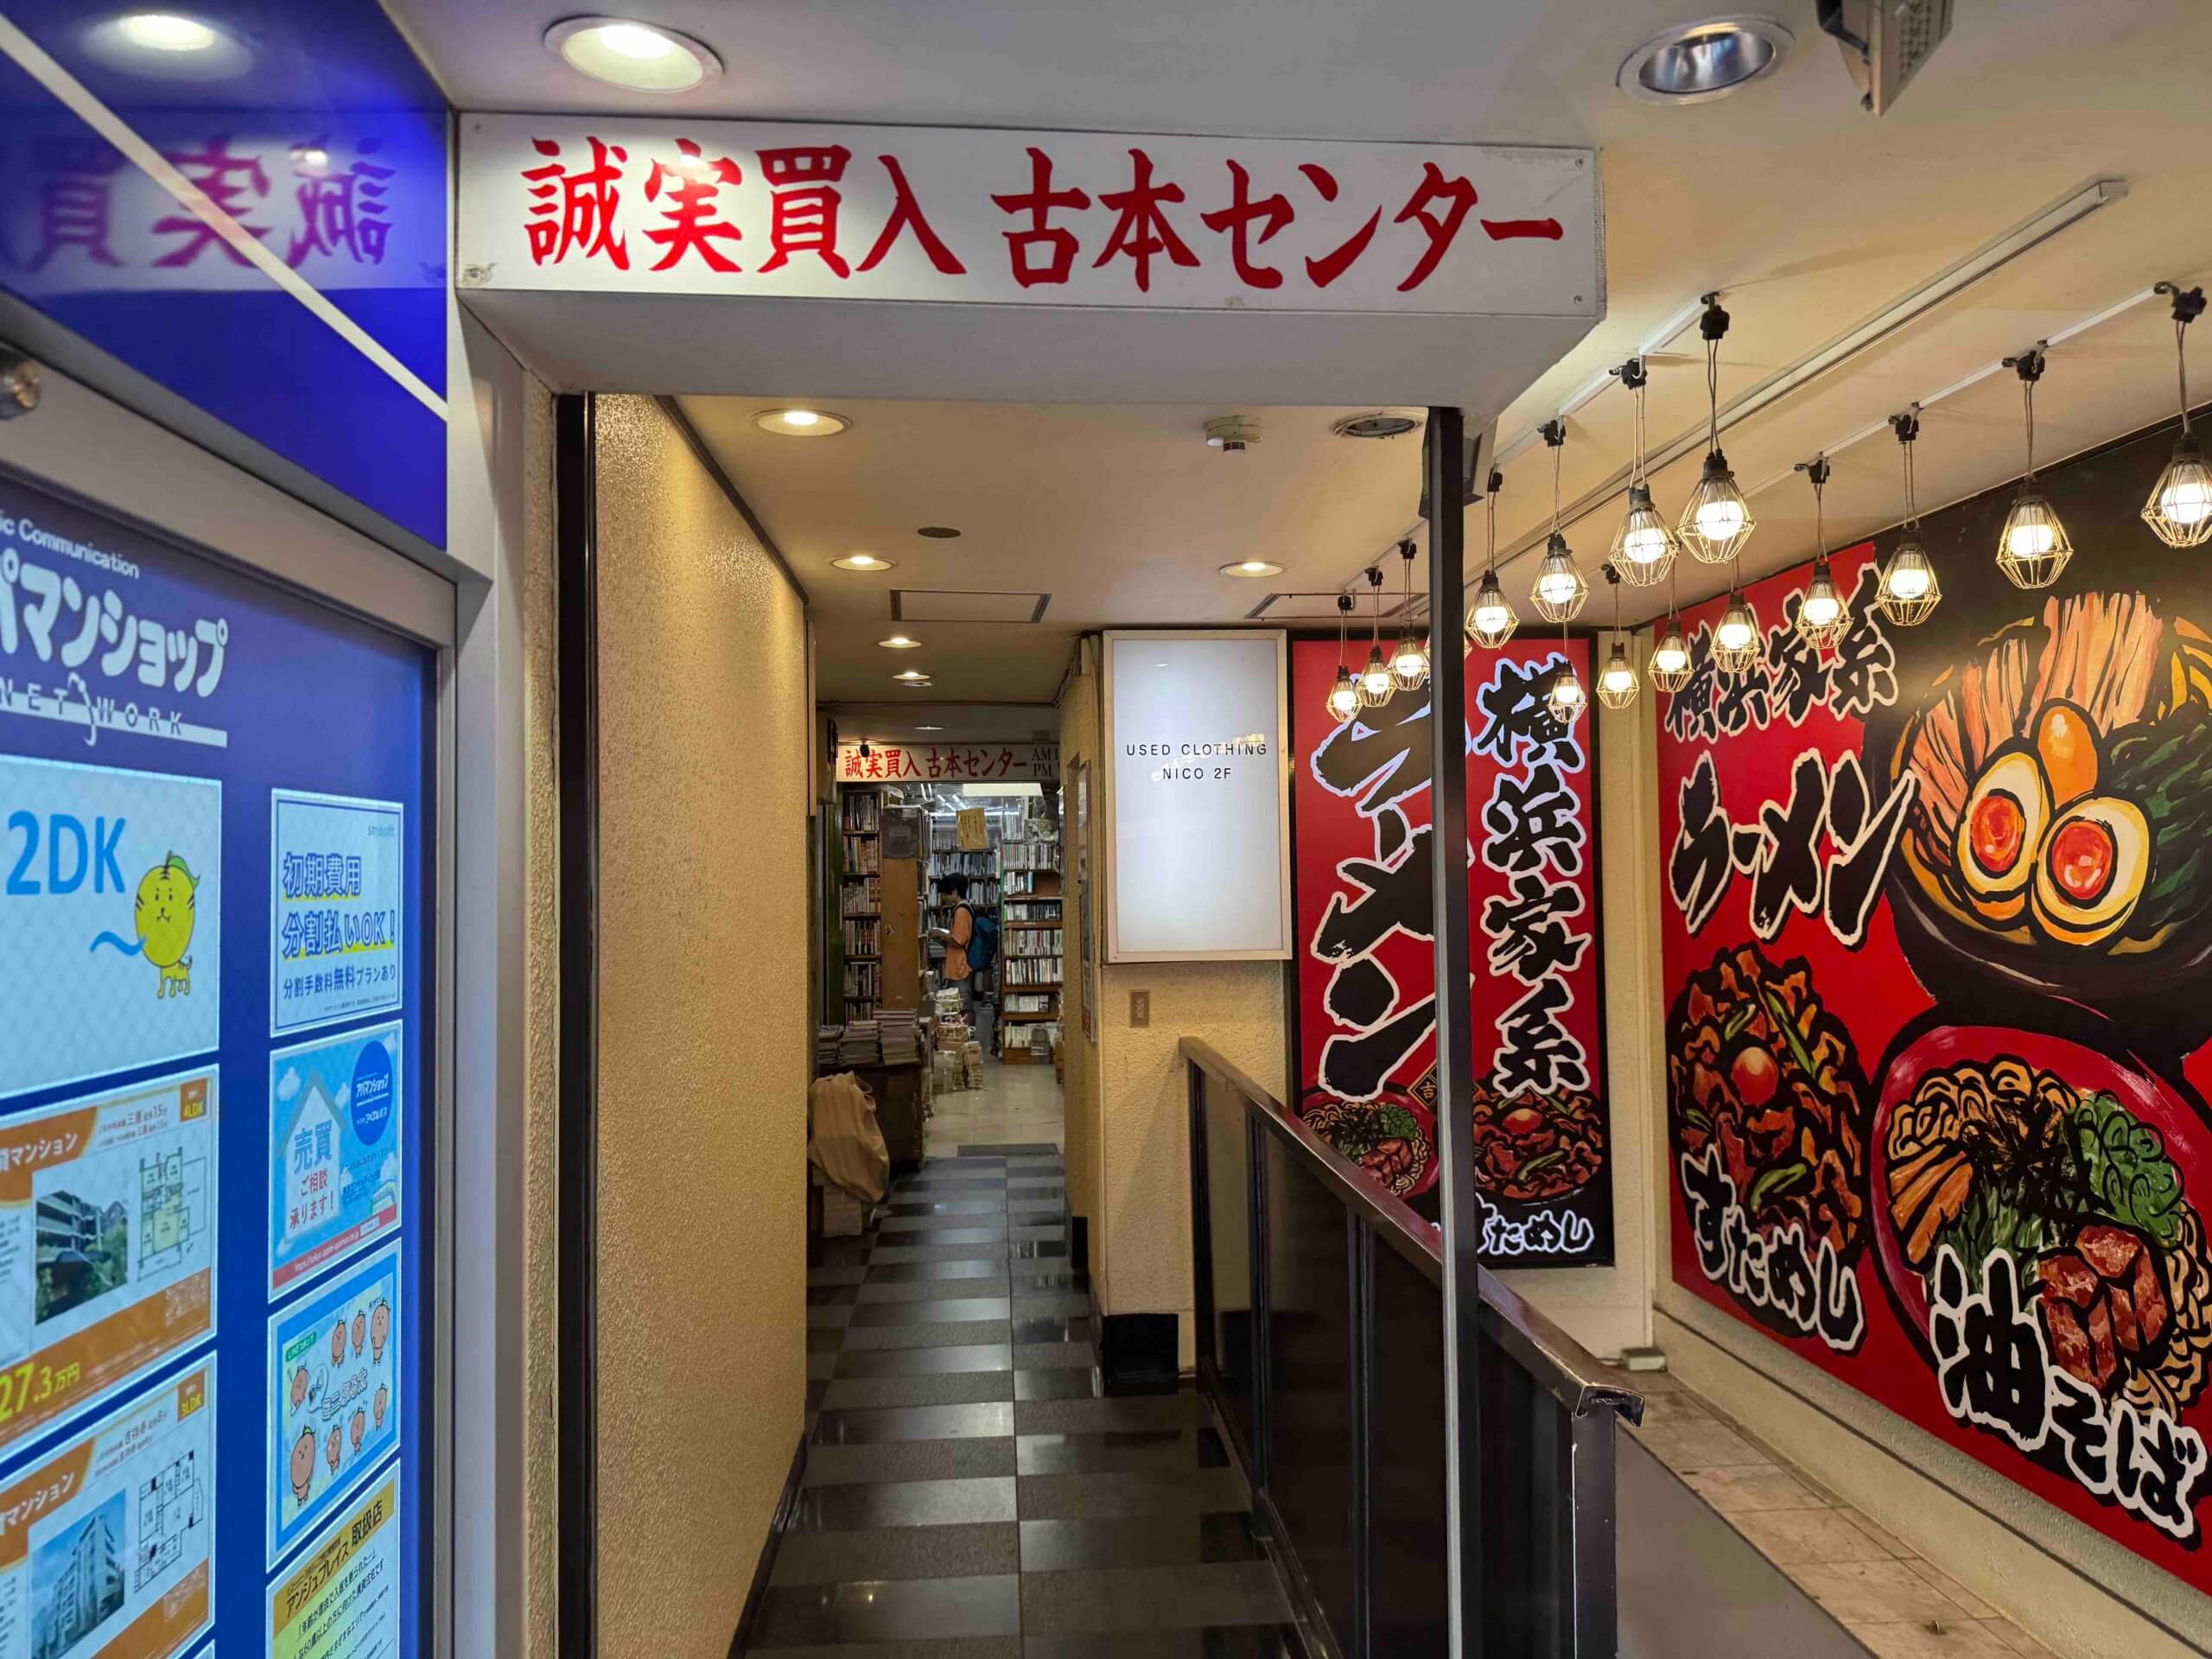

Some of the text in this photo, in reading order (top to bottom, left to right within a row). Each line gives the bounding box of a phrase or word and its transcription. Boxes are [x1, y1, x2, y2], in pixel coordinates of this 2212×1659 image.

[521, 135, 1564, 292] 誠実買入 古本センター
[19, 518, 139, 579] Communication
[844, 747, 1027, 779] 誠実買入 古本センター
[1126, 743, 1267, 757] USED CLOTHING
[1163, 767, 1231, 779] NICO 2F
[7, 810, 126, 895] 2DK
[283, 851, 361, 898] 初期費用
[1476, 652, 1593, 1097] 横浜家系
[1669, 747, 1916, 947] ラーメン
[294, 1120, 333, 1175] 売買
[289, 1189, 334, 1230] 承ります!
[300, 1168, 328, 1198] ご相談
[1476, 1192, 1595, 1255] ためし
[1929, 1243, 2208, 1538] 油そば
